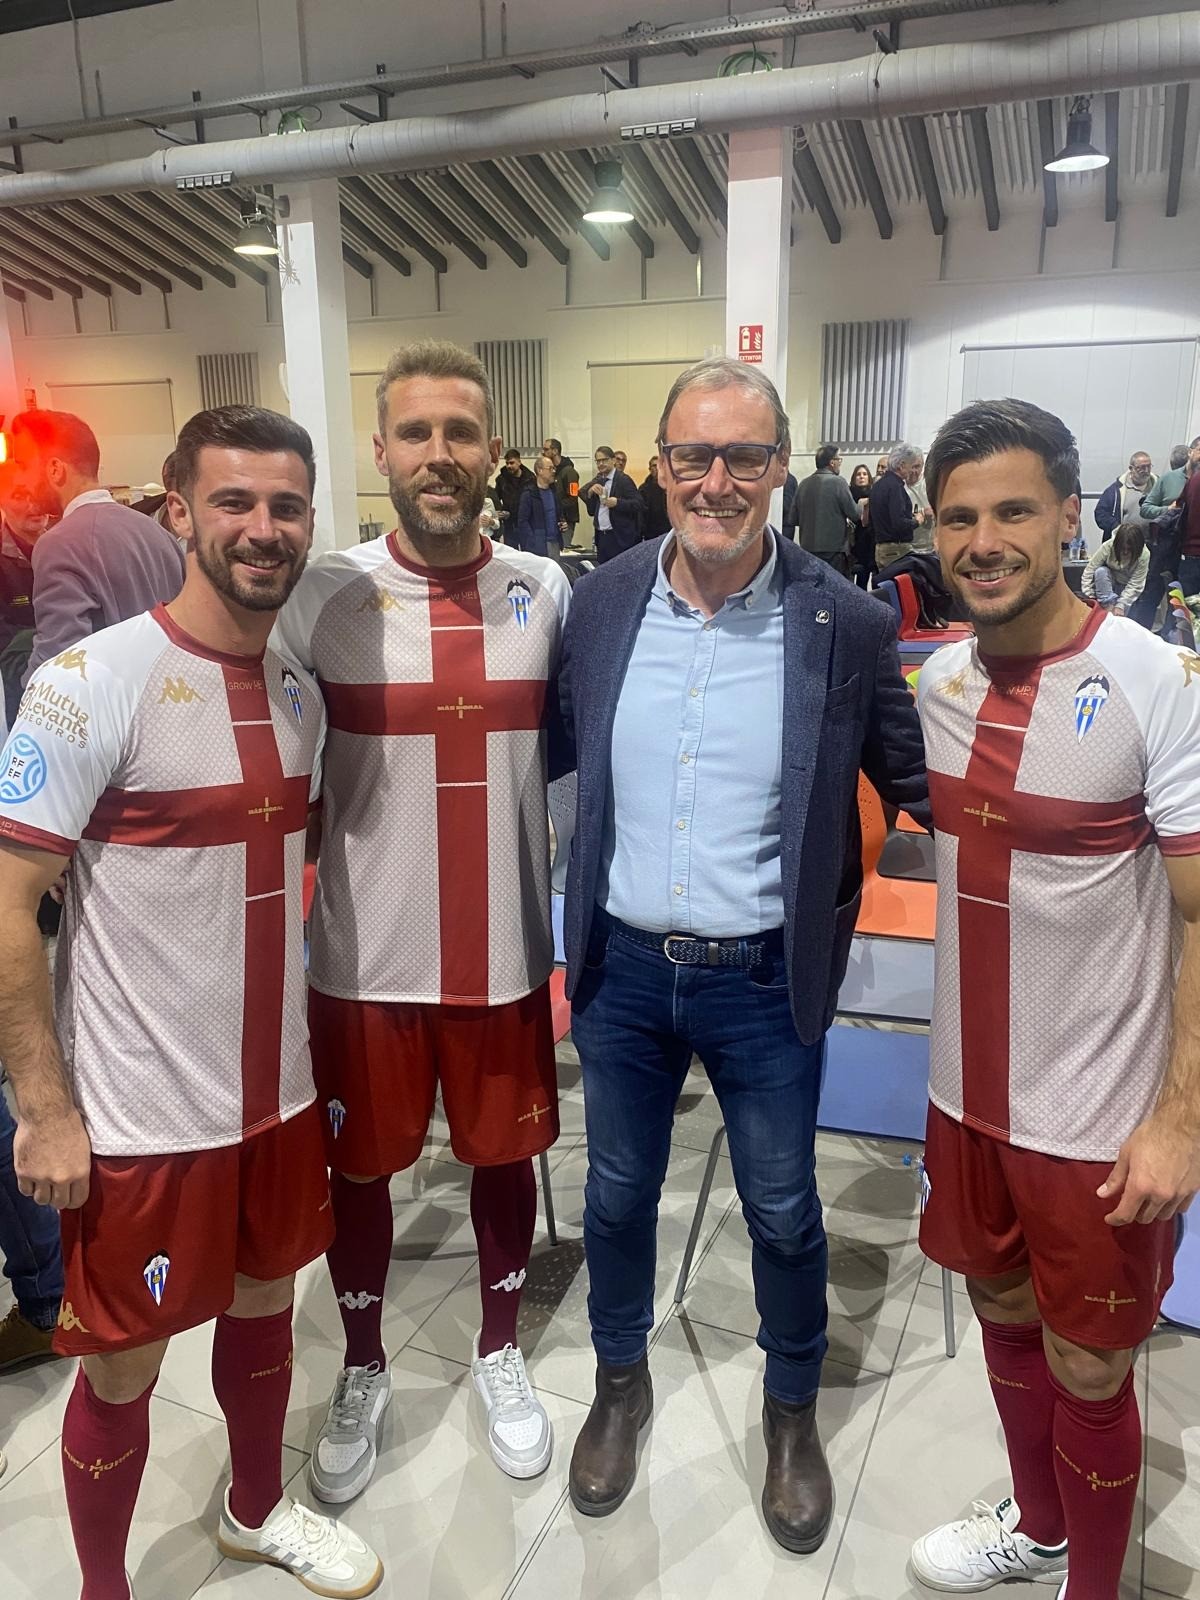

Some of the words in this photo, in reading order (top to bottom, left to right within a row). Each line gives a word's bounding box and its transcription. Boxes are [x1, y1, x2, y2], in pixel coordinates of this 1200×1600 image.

[35, 682, 88, 723] Mutua
[227, 681, 253, 690] GROW
[23, 712, 87, 749] SEGUROS
[28, 697, 88, 741] Levante
